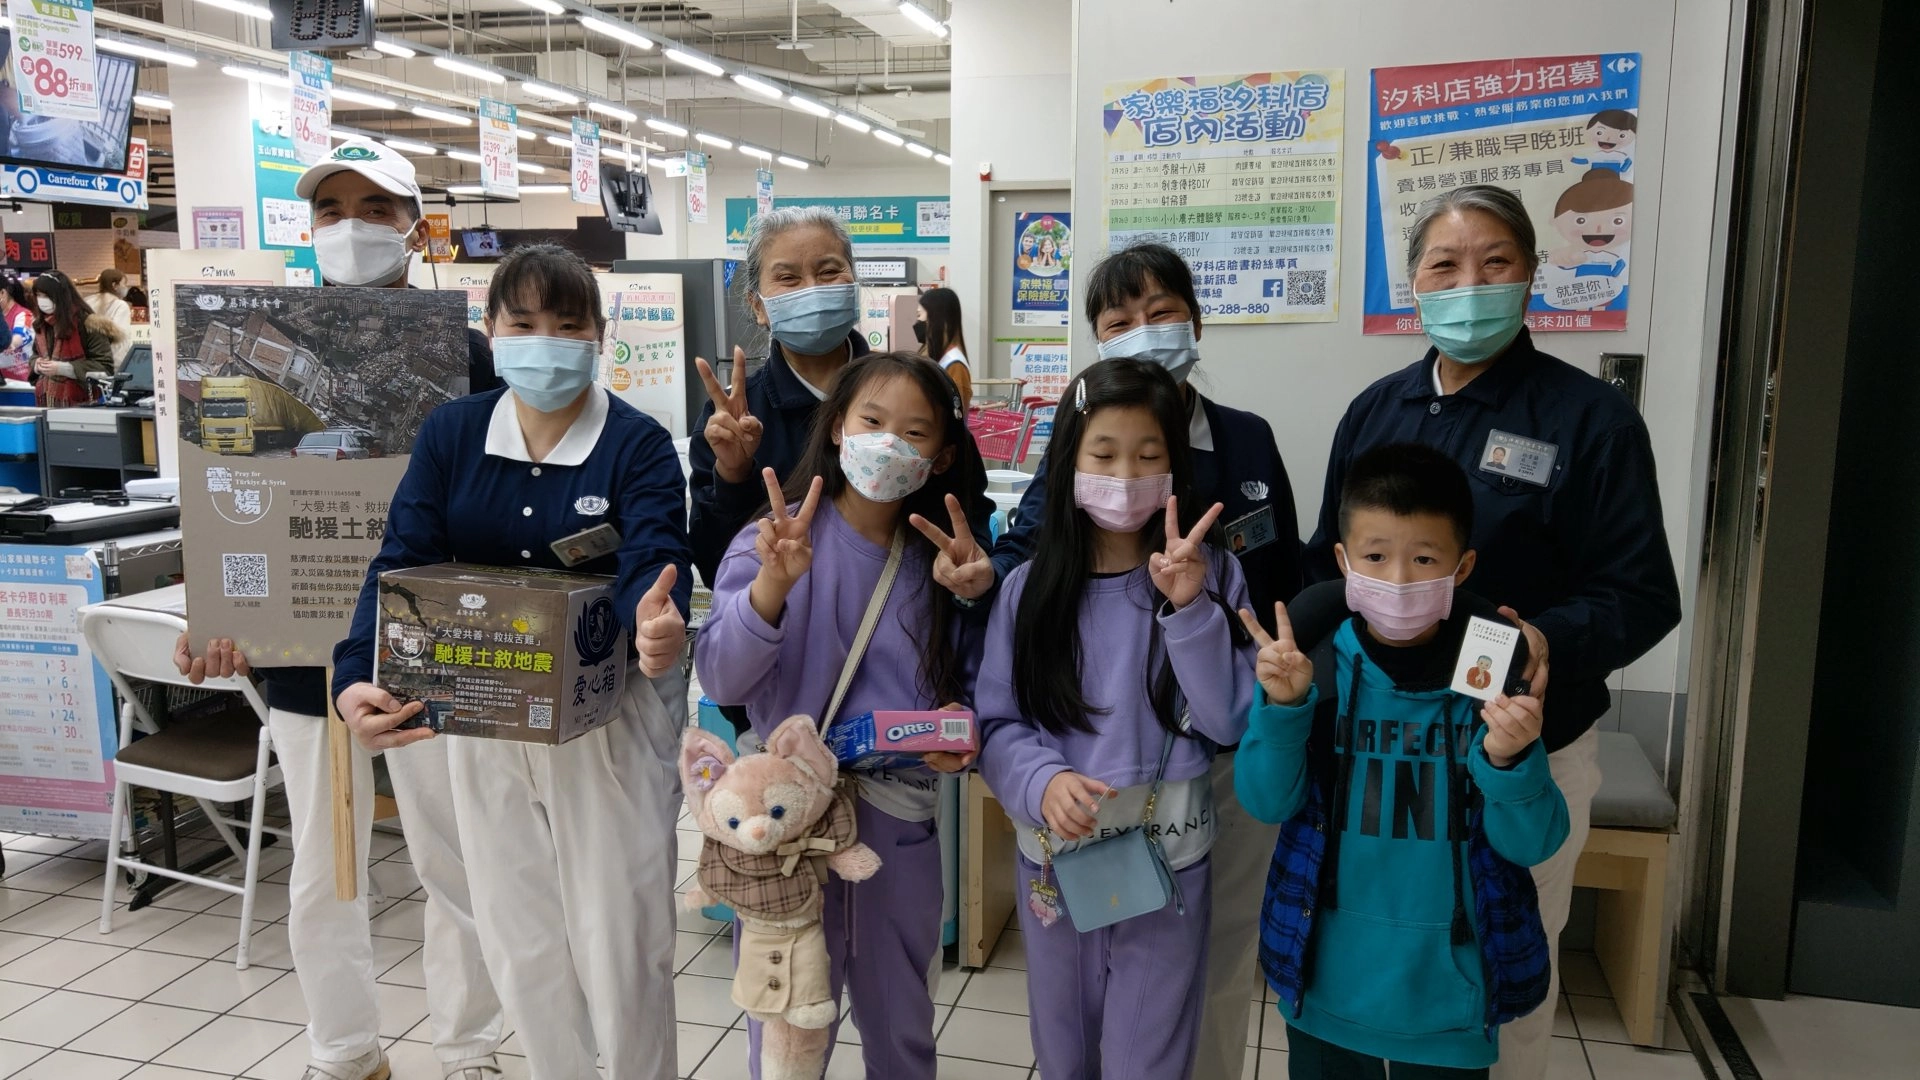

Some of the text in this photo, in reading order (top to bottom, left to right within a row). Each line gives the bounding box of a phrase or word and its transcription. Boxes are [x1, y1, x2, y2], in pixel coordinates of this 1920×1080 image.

[60, 44, 83, 60] 599
[35, 58, 68, 97] 88
[1382, 60, 1599, 111] 汐科店強力招募
[1121, 84, 1329, 120] 家樂福汐科店
[1380, 88, 1629, 131] 歡迎喜歡挑戰、熱愛服務業的您加入我們
[303, 117, 310, 141] 6
[1142, 109, 1306, 148] 店內活動
[489, 141, 501, 153] 399
[1410, 126, 1585, 167] 正/兼職早晚班
[492, 156, 498, 181] 1
[47, 173, 89, 187] Carrefour
[1396, 159, 1565, 194] 賣場營運服務專員
[1192, 257, 1299, 272] 汐科店臉書粉絲專頁
[1020, 278, 1053, 290] 家樂福
[1555, 277, 1612, 299] 就是你！
[1017, 290, 1069, 302] 保險經紀人
[228, 297, 284, 310] 慈濟基金會
[636, 349, 675, 363] 更安心
[1025, 354, 1068, 363] 家樂福汐科
[1025, 364, 1068, 373] 配合政府法
[636, 374, 673, 388] 更友善
[234, 471, 250, 479] Pray
[235, 478, 261, 488] Türkiye
[269, 479, 286, 487] Syria
[7, 607, 54, 619] 最長可分30期
[435, 625, 542, 647] 「大愛共善、救拔苦難」
[434, 643, 554, 673] 馳援土敘地震
[60, 659, 67, 672] 3
[61, 676, 69, 689] 6
[572, 664, 616, 707] 愛心箱
[60, 692, 74, 706] 12
[62, 709, 75, 722] 24
[64, 725, 77, 739] 30
[886, 722, 937, 742] OREO
[1100, 809, 1210, 839] EVRANC
